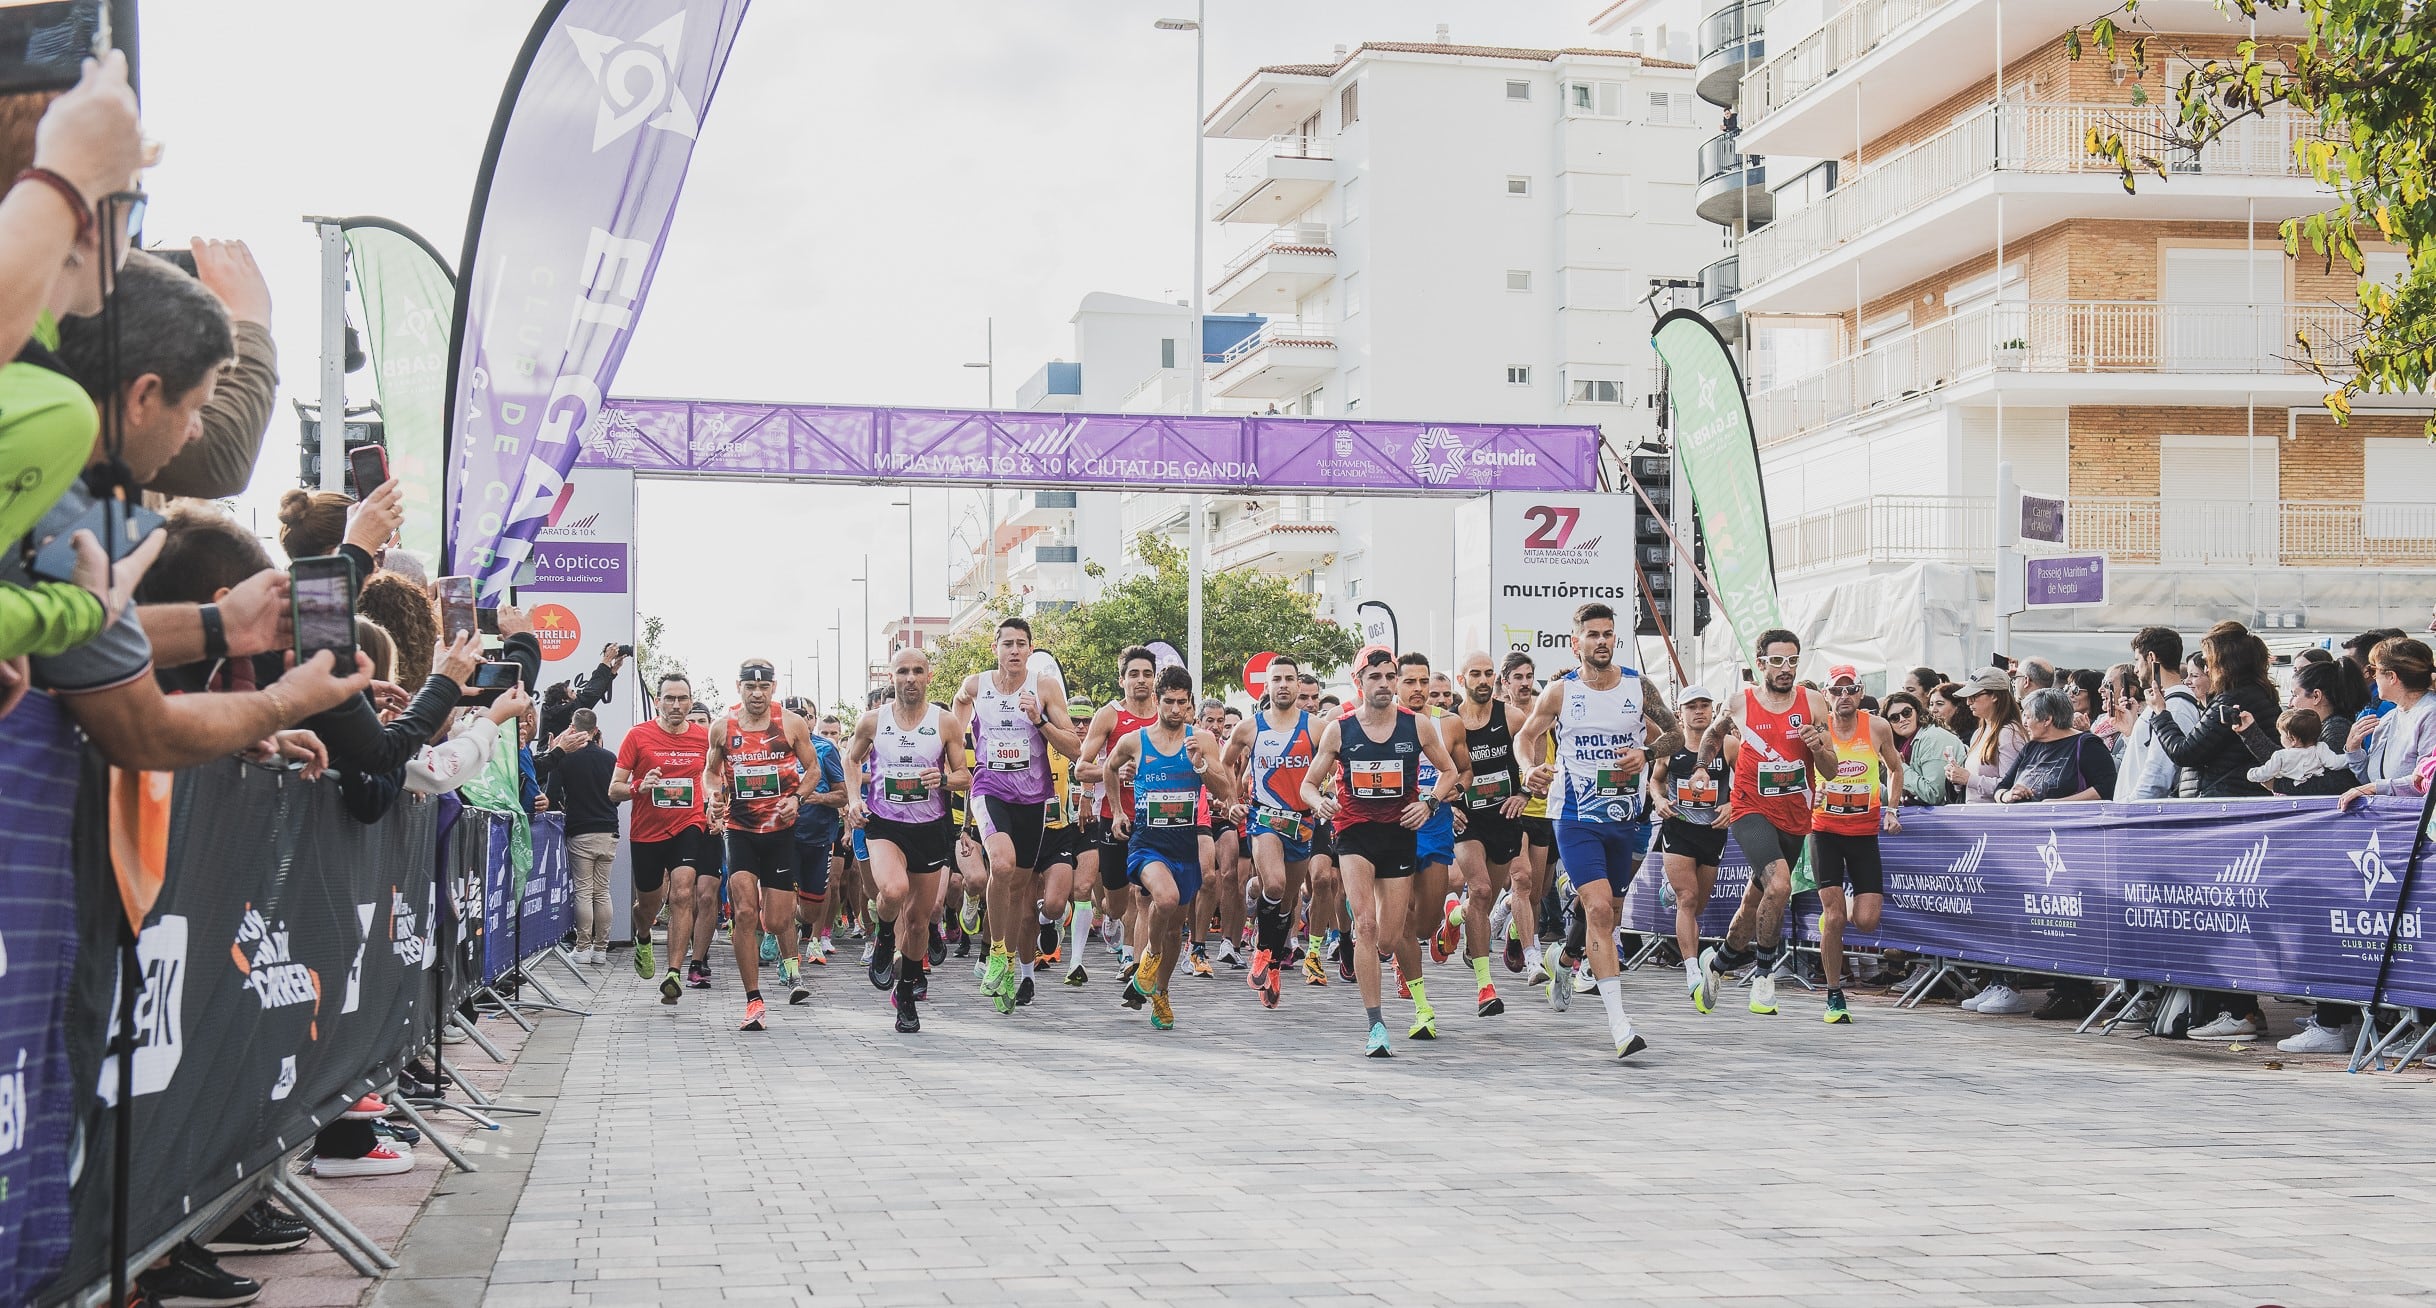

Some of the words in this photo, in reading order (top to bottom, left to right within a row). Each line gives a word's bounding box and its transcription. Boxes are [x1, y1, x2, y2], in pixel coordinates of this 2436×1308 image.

[493, 401, 526, 457] DE
[609, 429, 640, 439] Gandia
[1316, 459, 1371, 468] AJUNTAMENT
[1472, 449, 1537, 466] Gandia
[873, 453, 929, 471] MITJA
[1019, 457, 1034, 473] &
[1041, 458, 1062, 474] 10
[1066, 459, 1079, 474] K
[1085, 459, 1150, 476] CIUTAT
[1155, 461, 1179, 477] DE
[1184, 461, 1260, 478] GANDIA
[1333, 469, 1367, 477] GANDIA
[1524, 505, 1580, 549] 27
[555, 554, 620, 572] ópticos
[567, 574, 603, 583] auditivos
[2038, 567, 2062, 580] Passeig
[2048, 583, 2056, 594] de
[997, 749, 1020, 759] 3900
[1370, 762, 1381, 770] 27
[1145, 772, 1167, 783] RF&B
[1371, 773, 1382, 783] 15
[1890, 873, 1915, 890] MITJA
[1954, 876, 1964, 893] &
[1963, 876, 1977, 893] 10
[1976, 877, 1986, 893] K
[2124, 883, 2161, 903] MITJA
[2225, 886, 2236, 907] &
[2239, 887, 2255, 908] 10
[2259, 888, 2269, 909] K
[1892, 893, 1921, 910] CIUTAT
[1921, 895, 1935, 911] DE
[1935, 896, 1973, 914] GANDIA
[2023, 893, 2041, 914] EL
[2041, 890, 2083, 917] GARBÍ
[2030, 918, 2045, 926] CLUB
[2125, 907, 2170, 929] CIUTAT
[2172, 910, 2192, 930] DE
[2194, 911, 2251, 934] GANDIA
[2330, 909, 2356, 934] EL
[2043, 929, 2065, 937] GANDIA
[2341, 939, 2363, 948] CLUB
[2366, 941, 2377, 949] DE
[2380, 942, 2413, 952] CRRER
